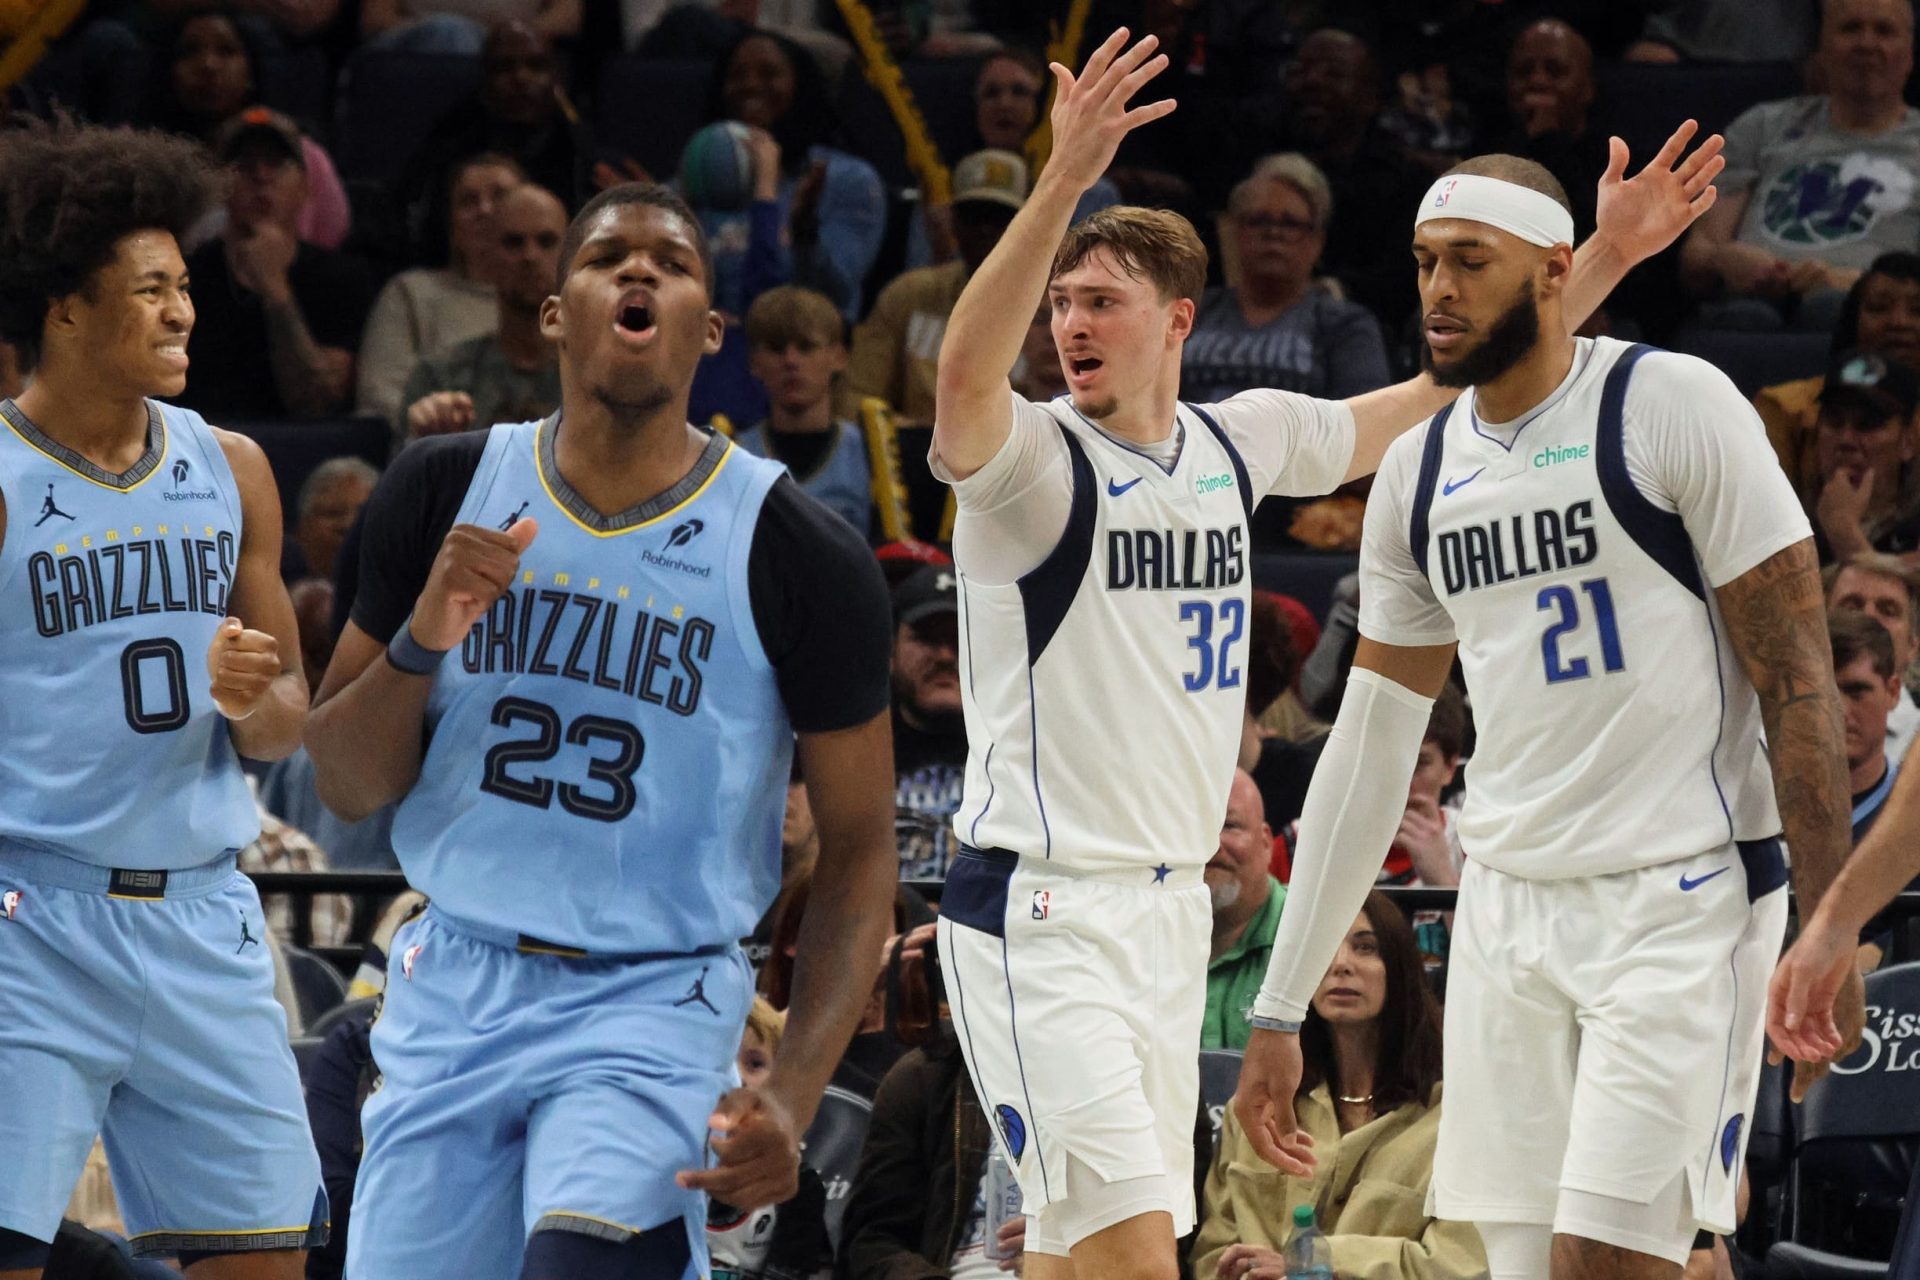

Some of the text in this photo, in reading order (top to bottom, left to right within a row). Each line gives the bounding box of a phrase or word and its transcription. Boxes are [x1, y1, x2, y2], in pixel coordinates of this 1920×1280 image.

[163, 489, 217, 502] Robinhood
[1196, 473, 1234, 495] chime
[1533, 444, 1590, 469] chime
[28, 530, 234, 638] GRIZZLIES
[641, 550, 712, 578] Robinhood
[1106, 523, 1244, 592] DALLAS
[1437, 497, 1598, 599] DALLAS
[523, 570, 683, 620] EMPHIS
[1536, 576, 1627, 686] 21
[120, 636, 191, 735] 0
[1178, 596, 1245, 694] 32
[479, 694, 646, 824] 23
